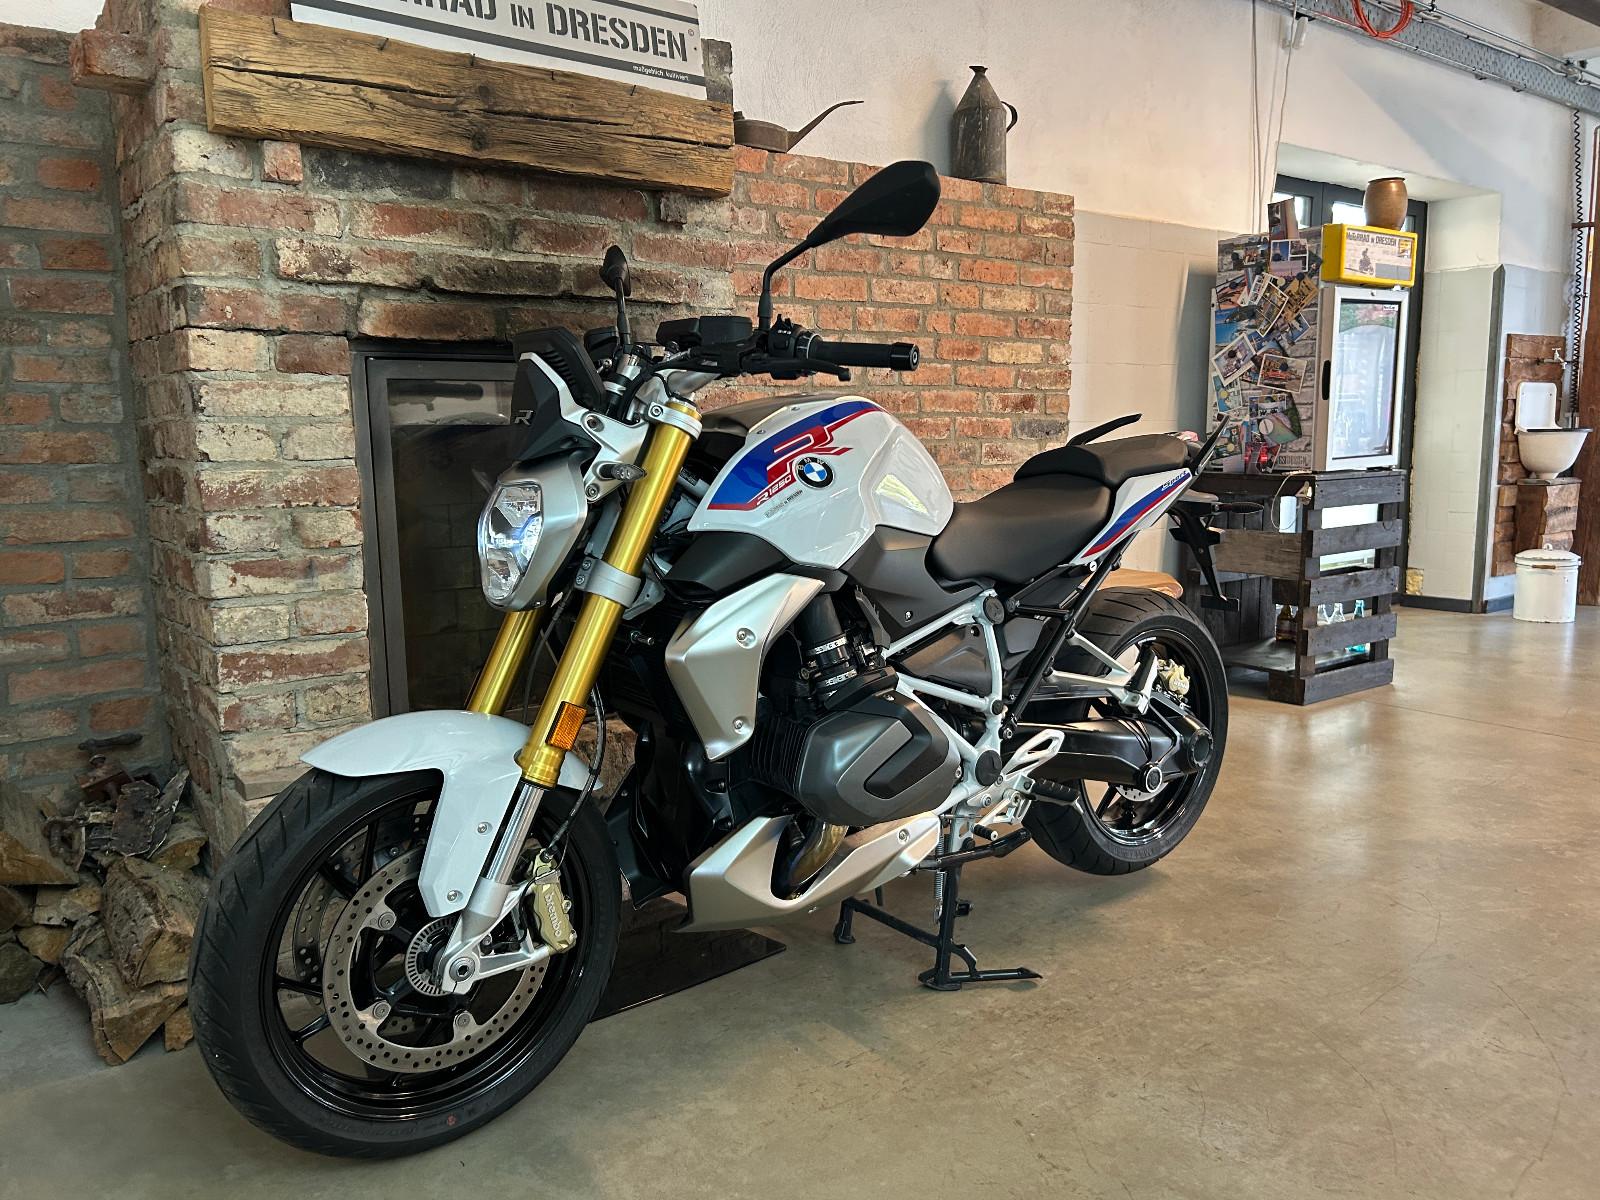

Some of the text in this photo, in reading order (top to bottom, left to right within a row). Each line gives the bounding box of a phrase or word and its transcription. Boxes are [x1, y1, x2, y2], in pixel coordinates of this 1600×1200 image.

[510, 3, 535, 30] IN
[546, 2, 688, 62] DRESDEN
[1376, 236, 1396, 247] DRESDEN
[514, 409, 534, 426] R
[544, 891, 562, 937] brembo
